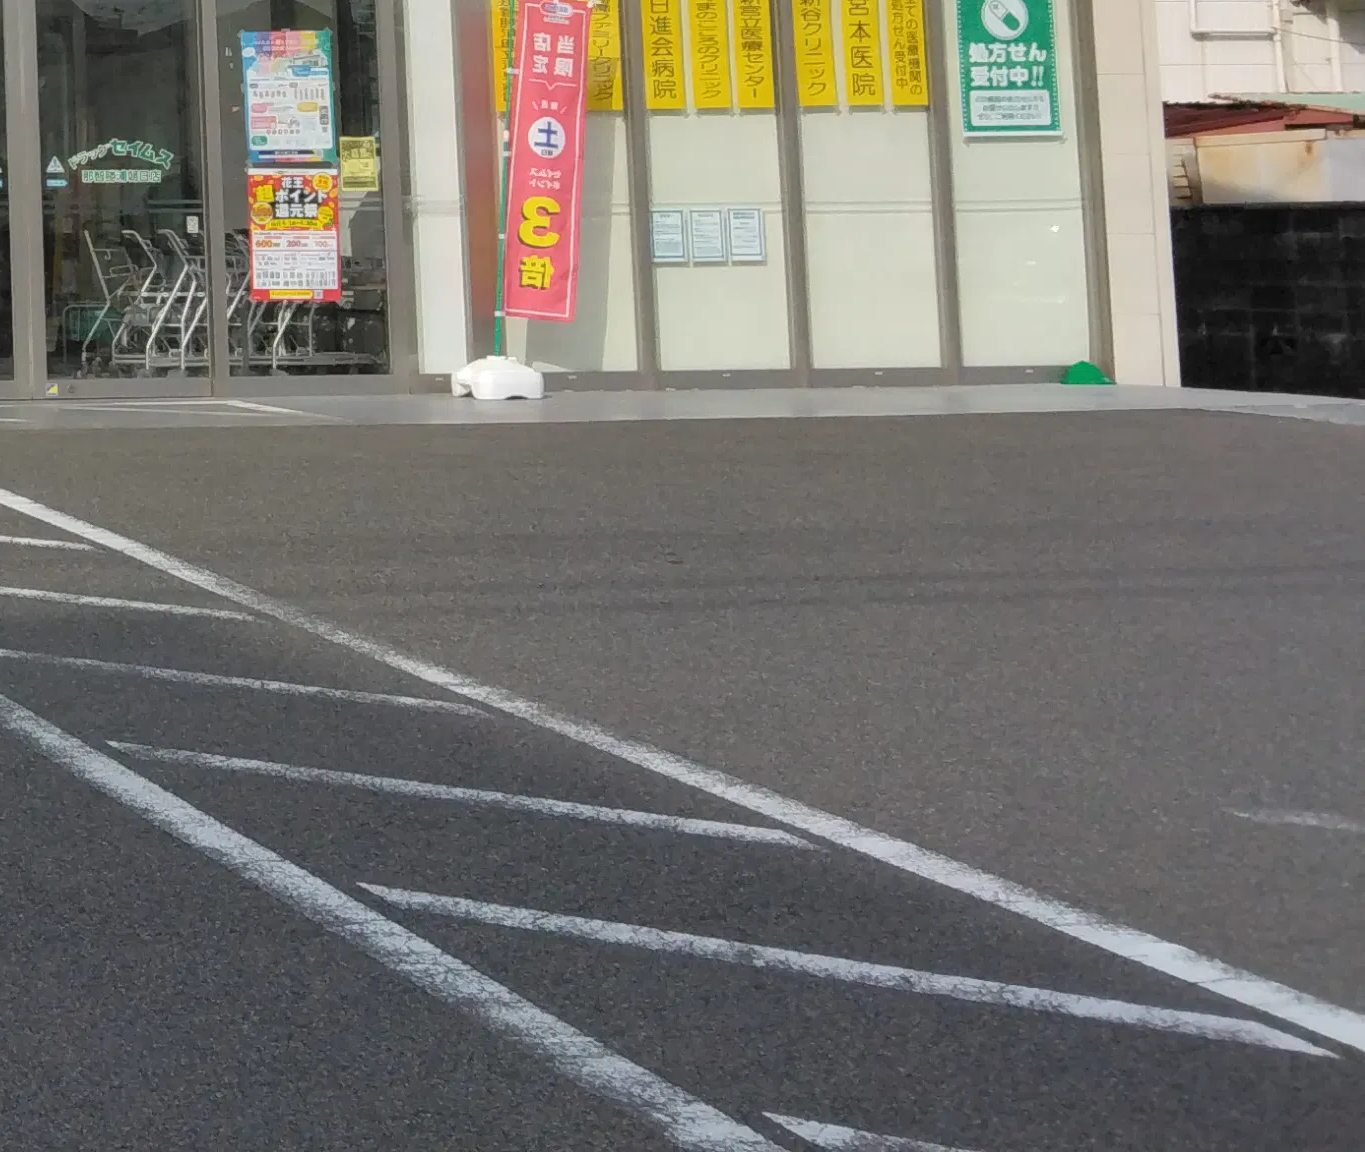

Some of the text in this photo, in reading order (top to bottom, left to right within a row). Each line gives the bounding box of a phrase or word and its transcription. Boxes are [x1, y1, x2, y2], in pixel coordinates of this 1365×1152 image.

[968, 41, 1047, 63] 処方せん
[109, 137, 175, 170] セイムス
[281, 175, 305, 189] 花王
[274, 188, 328, 204] ポイント
